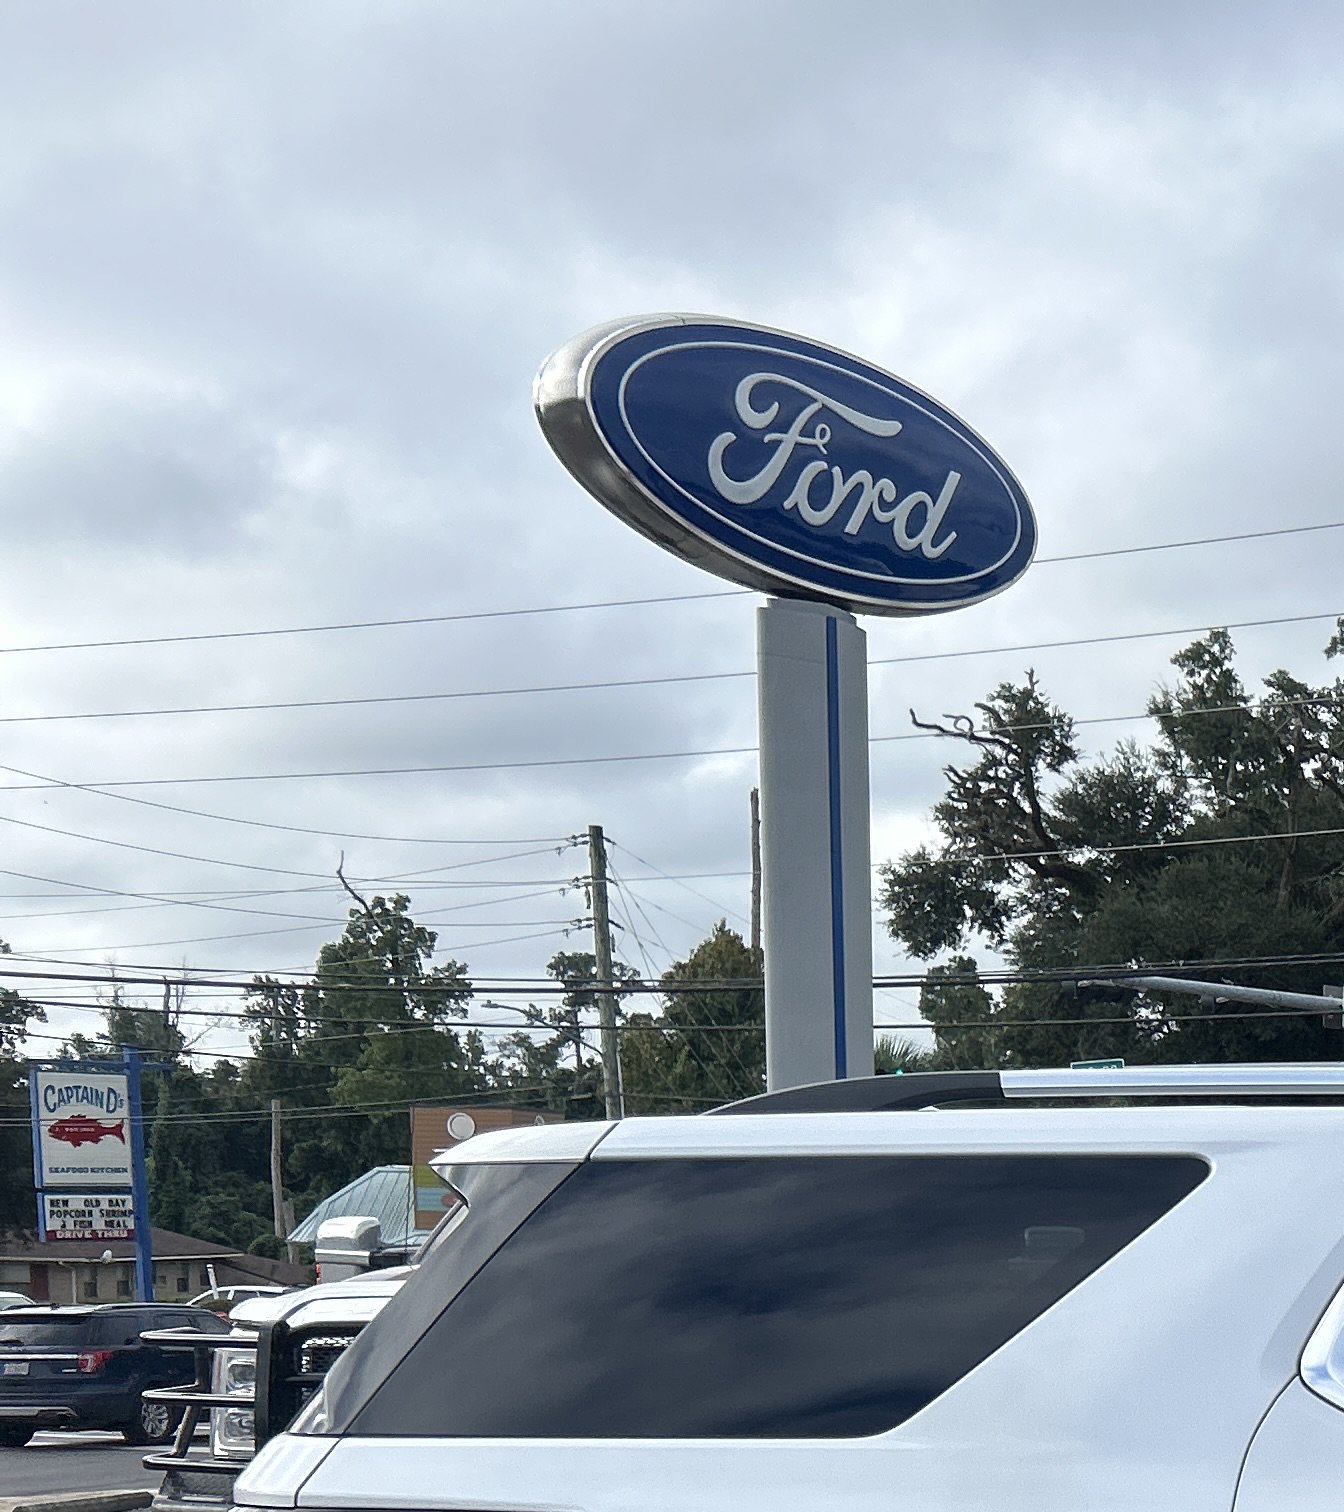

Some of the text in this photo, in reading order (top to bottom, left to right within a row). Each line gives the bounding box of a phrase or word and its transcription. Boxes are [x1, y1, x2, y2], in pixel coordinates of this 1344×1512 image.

[708, 372, 961, 560] Ford
[44, 1085, 104, 1113] CAPTAIN
[49, 1209, 93, 1218] POPCORN
[56, 1229, 128, 1239] DRIVE THRU
